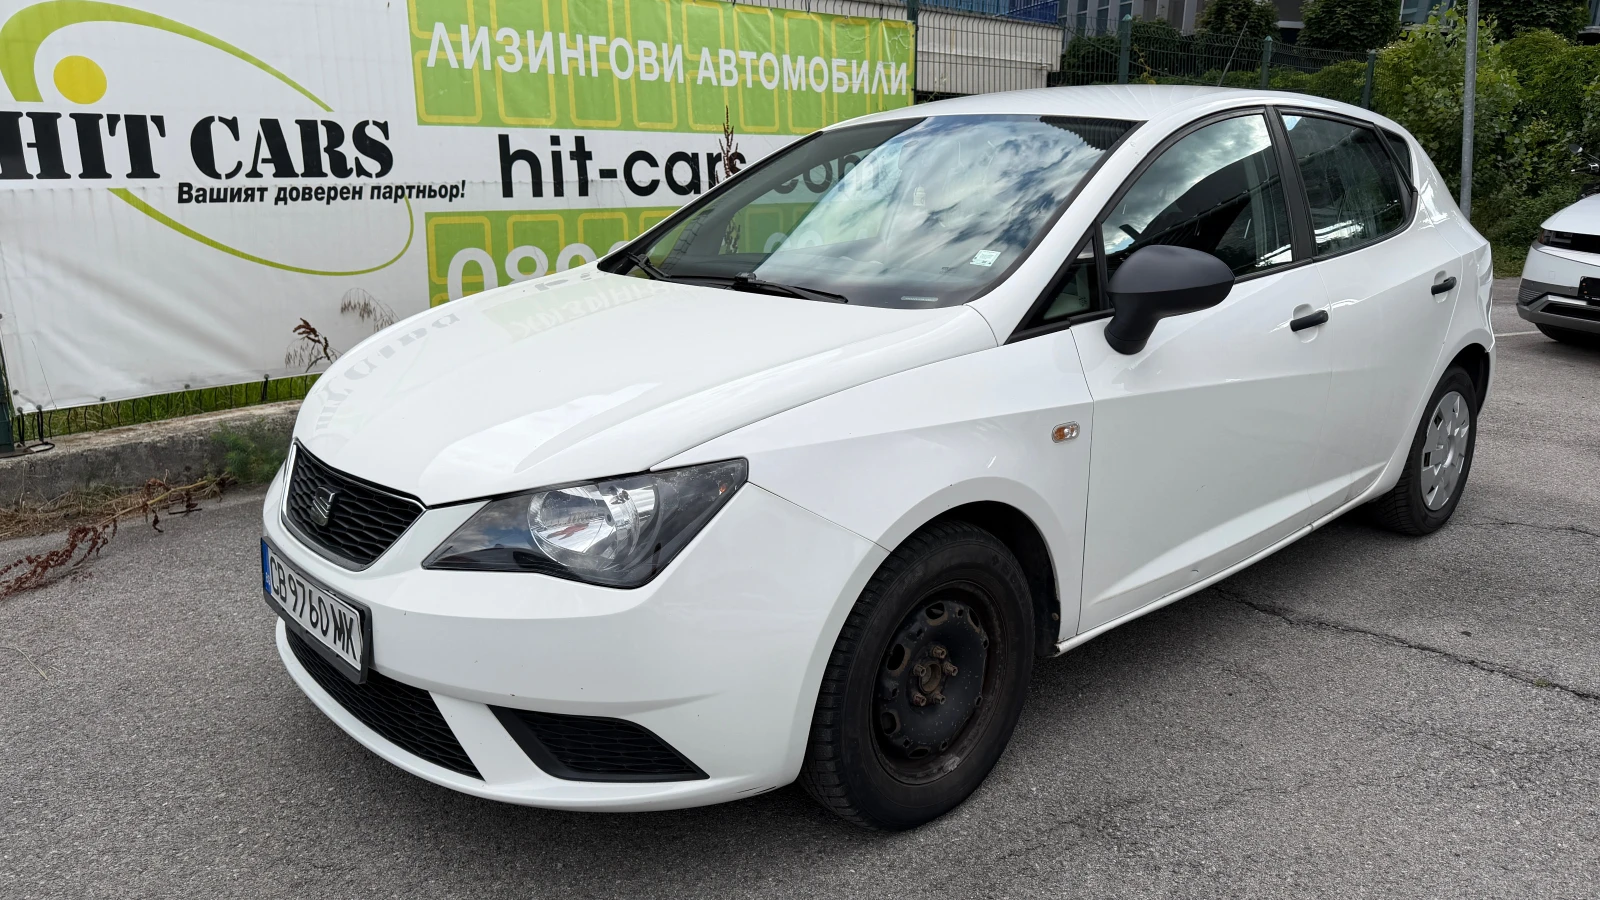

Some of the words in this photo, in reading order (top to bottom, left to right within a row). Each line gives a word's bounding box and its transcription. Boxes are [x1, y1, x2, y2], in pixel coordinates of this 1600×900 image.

[427, 22, 684, 84] ЛИЗИНГОВИ
[696, 46, 907, 96] АВТОМОБИЛИ
[0, 110, 167, 181] HIT
[190, 115, 394, 180] CARS
[177, 182, 268, 204] Вашият
[274, 183, 363, 205] доверен
[370, 179, 466, 201] партньор!
